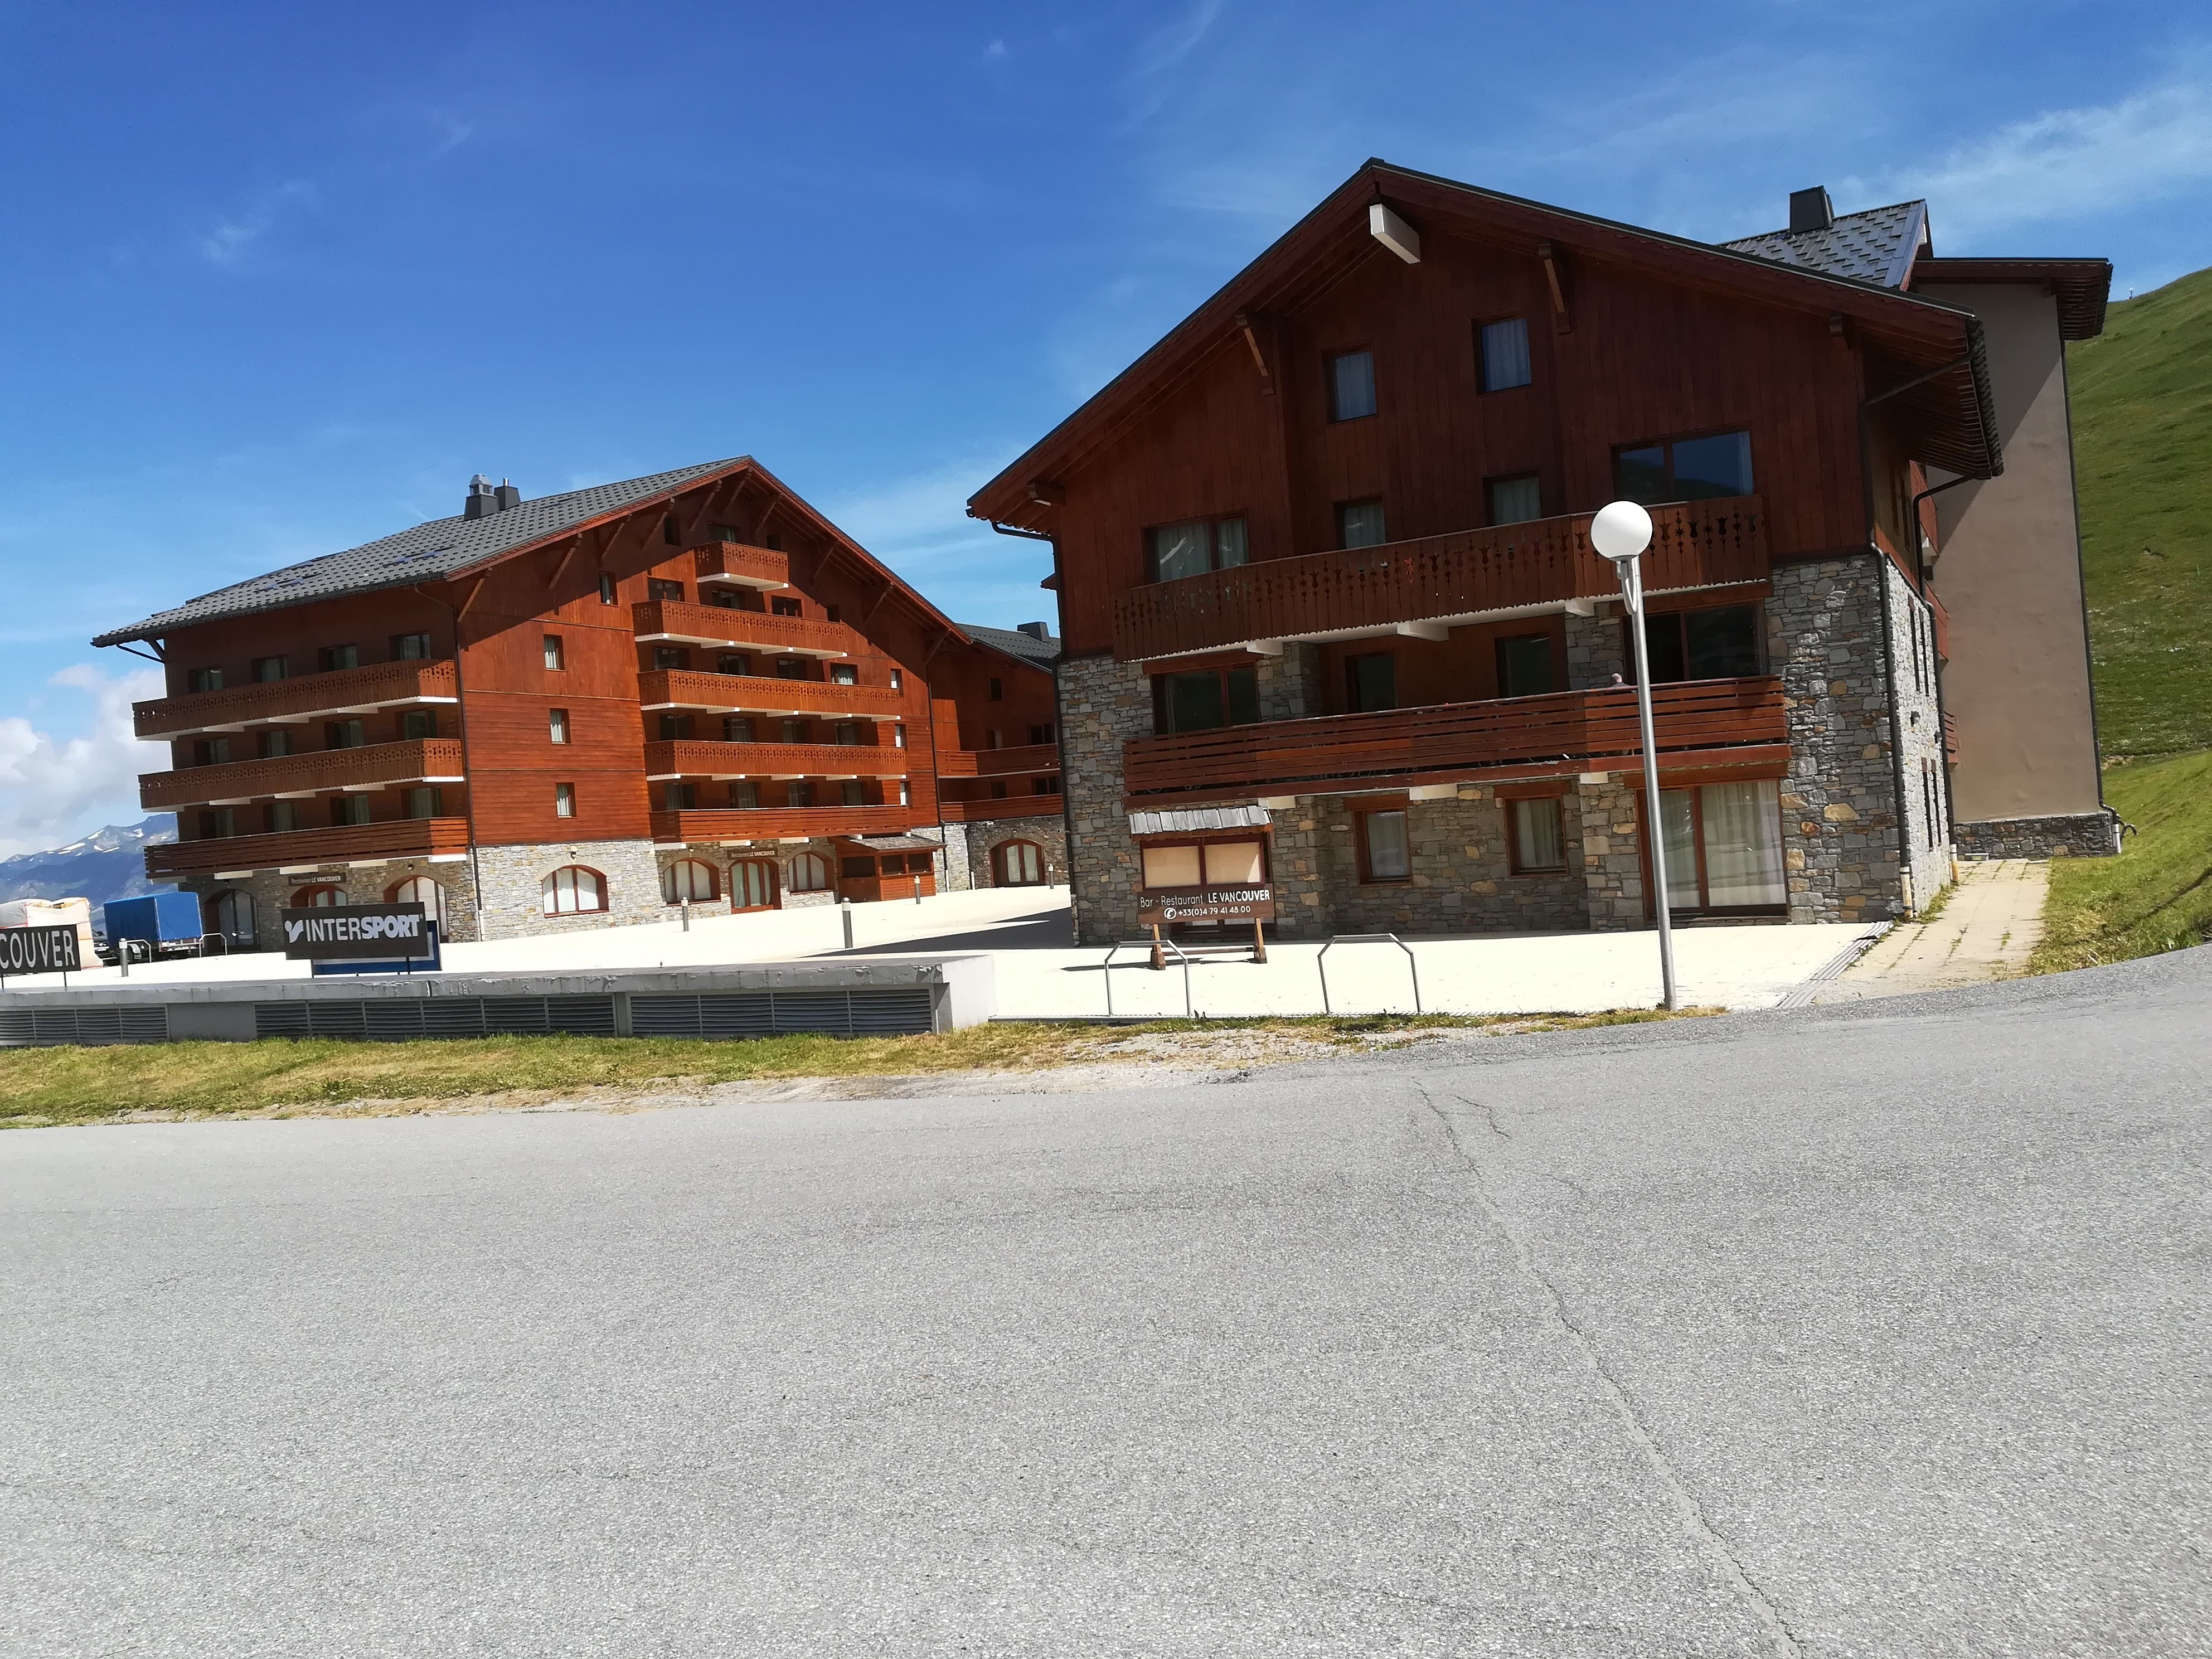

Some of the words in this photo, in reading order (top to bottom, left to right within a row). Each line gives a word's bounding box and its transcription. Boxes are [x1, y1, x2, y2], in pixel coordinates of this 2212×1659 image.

[1140, 896, 1153, 908] Bar
[1161, 893, 1204, 906] Restaurant
[1208, 892, 1217, 903] LE
[1219, 889, 1270, 902] VANCOUVER
[1178, 908, 1207, 916] +33(0)4
[305, 914, 419, 942] INTERSPORT
